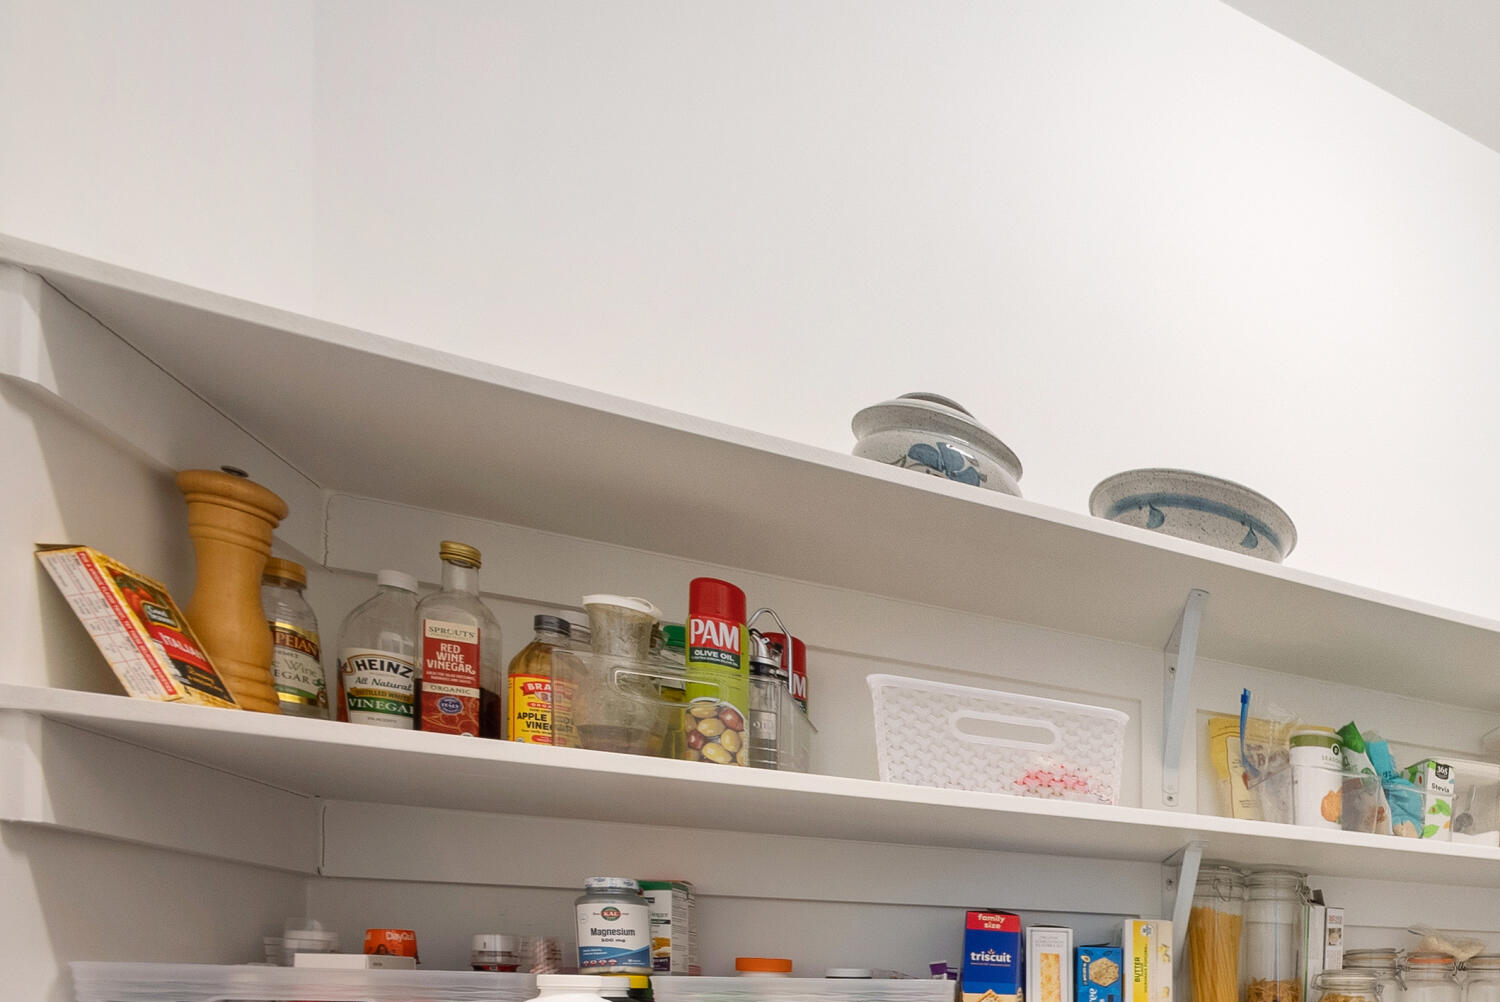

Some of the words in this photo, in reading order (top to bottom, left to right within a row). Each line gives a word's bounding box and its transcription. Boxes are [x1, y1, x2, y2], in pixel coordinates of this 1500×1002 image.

[690, 618, 740, 651] PAM
[276, 631, 316, 657] PEIAN
[440, 643, 461, 654] RED
[436, 651, 465, 663] WINE
[720, 653, 734, 661] OIL
[355, 659, 413, 679] HEINZ
[426, 659, 476, 675] VINEGAR
[372, 677, 412, 692] Natural
[430, 685, 471, 695] ORGANIC
[517, 711, 547, 722] APPLE
[1431, 782, 1450, 793] Stevia
[977, 913, 1006, 924] family
[984, 922, 1001, 930] size
[590, 928, 635, 938] Magnesium
[970, 950, 1012, 962] triscuit
